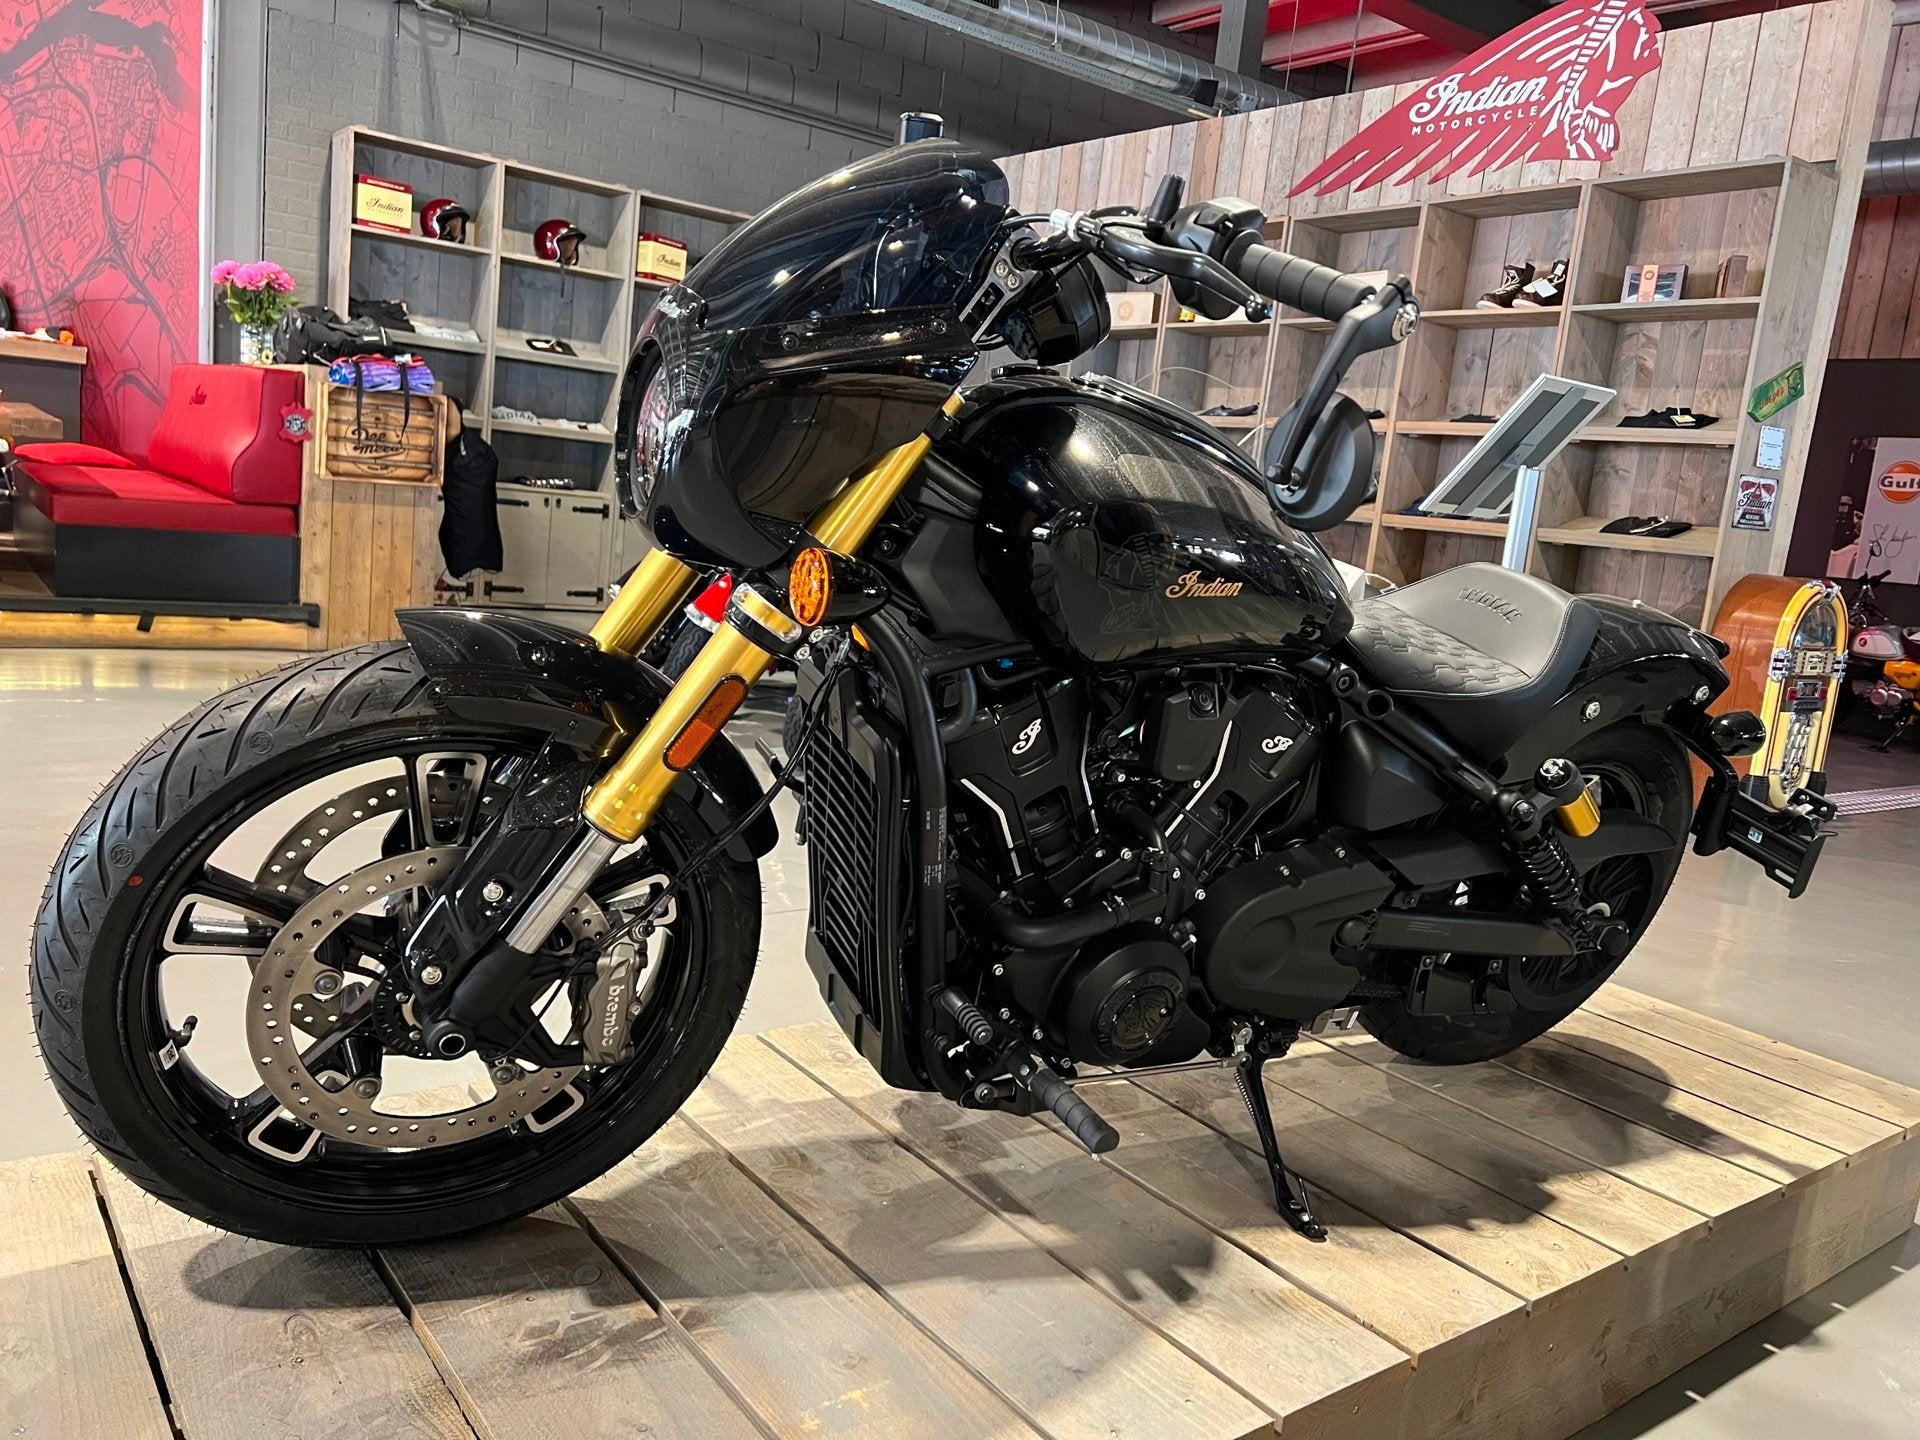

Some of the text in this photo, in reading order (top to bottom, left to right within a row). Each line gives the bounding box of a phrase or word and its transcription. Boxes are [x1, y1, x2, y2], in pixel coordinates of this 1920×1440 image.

[1408, 72, 1549, 124] Indian
[1411, 105, 1539, 136] MOTORCYCLE
[366, 197, 405, 214] Indian
[656, 254, 682, 268] Indian
[1738, 491, 1773, 510] Indian
[1165, 570, 1244, 598] Indian
[1458, 588, 1523, 624] INDIAN
[601, 984, 625, 1047] brembo
